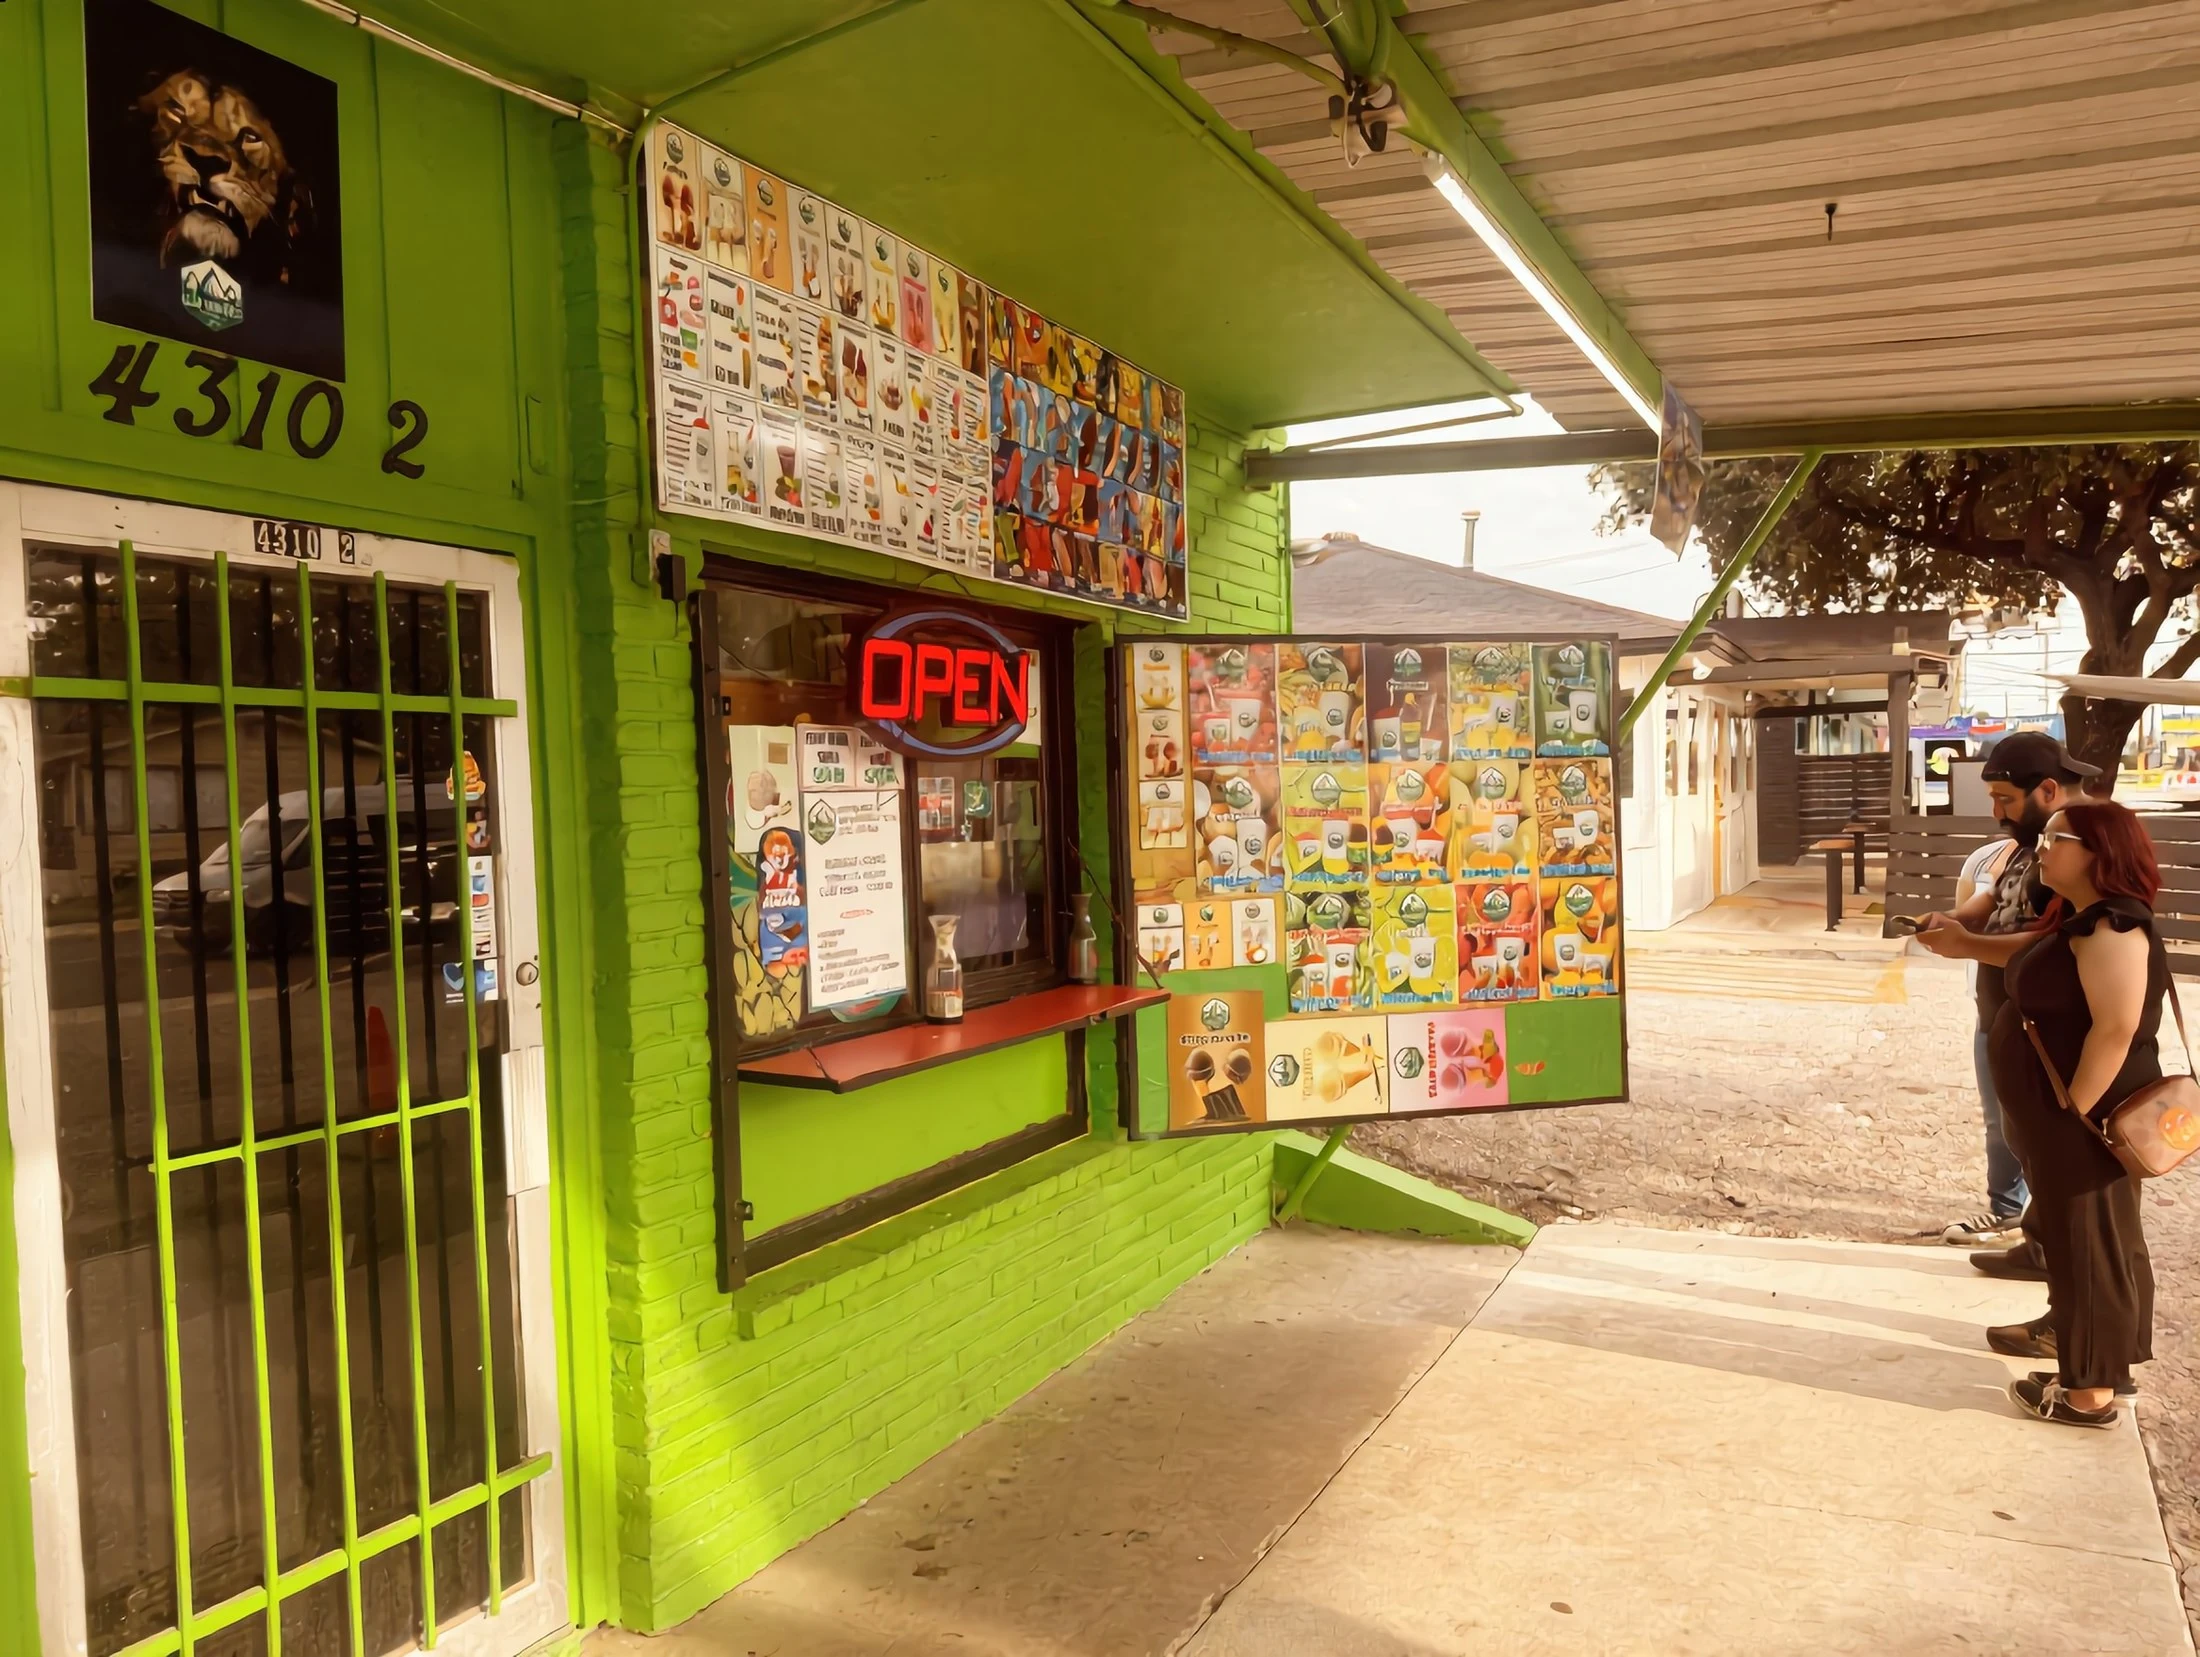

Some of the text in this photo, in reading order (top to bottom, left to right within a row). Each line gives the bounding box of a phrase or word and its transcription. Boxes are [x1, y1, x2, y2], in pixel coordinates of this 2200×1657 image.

[88, 341, 429, 479] 4310 2
[256, 521, 354, 563] 4310 2
[862, 639, 1030, 725] OPEN
